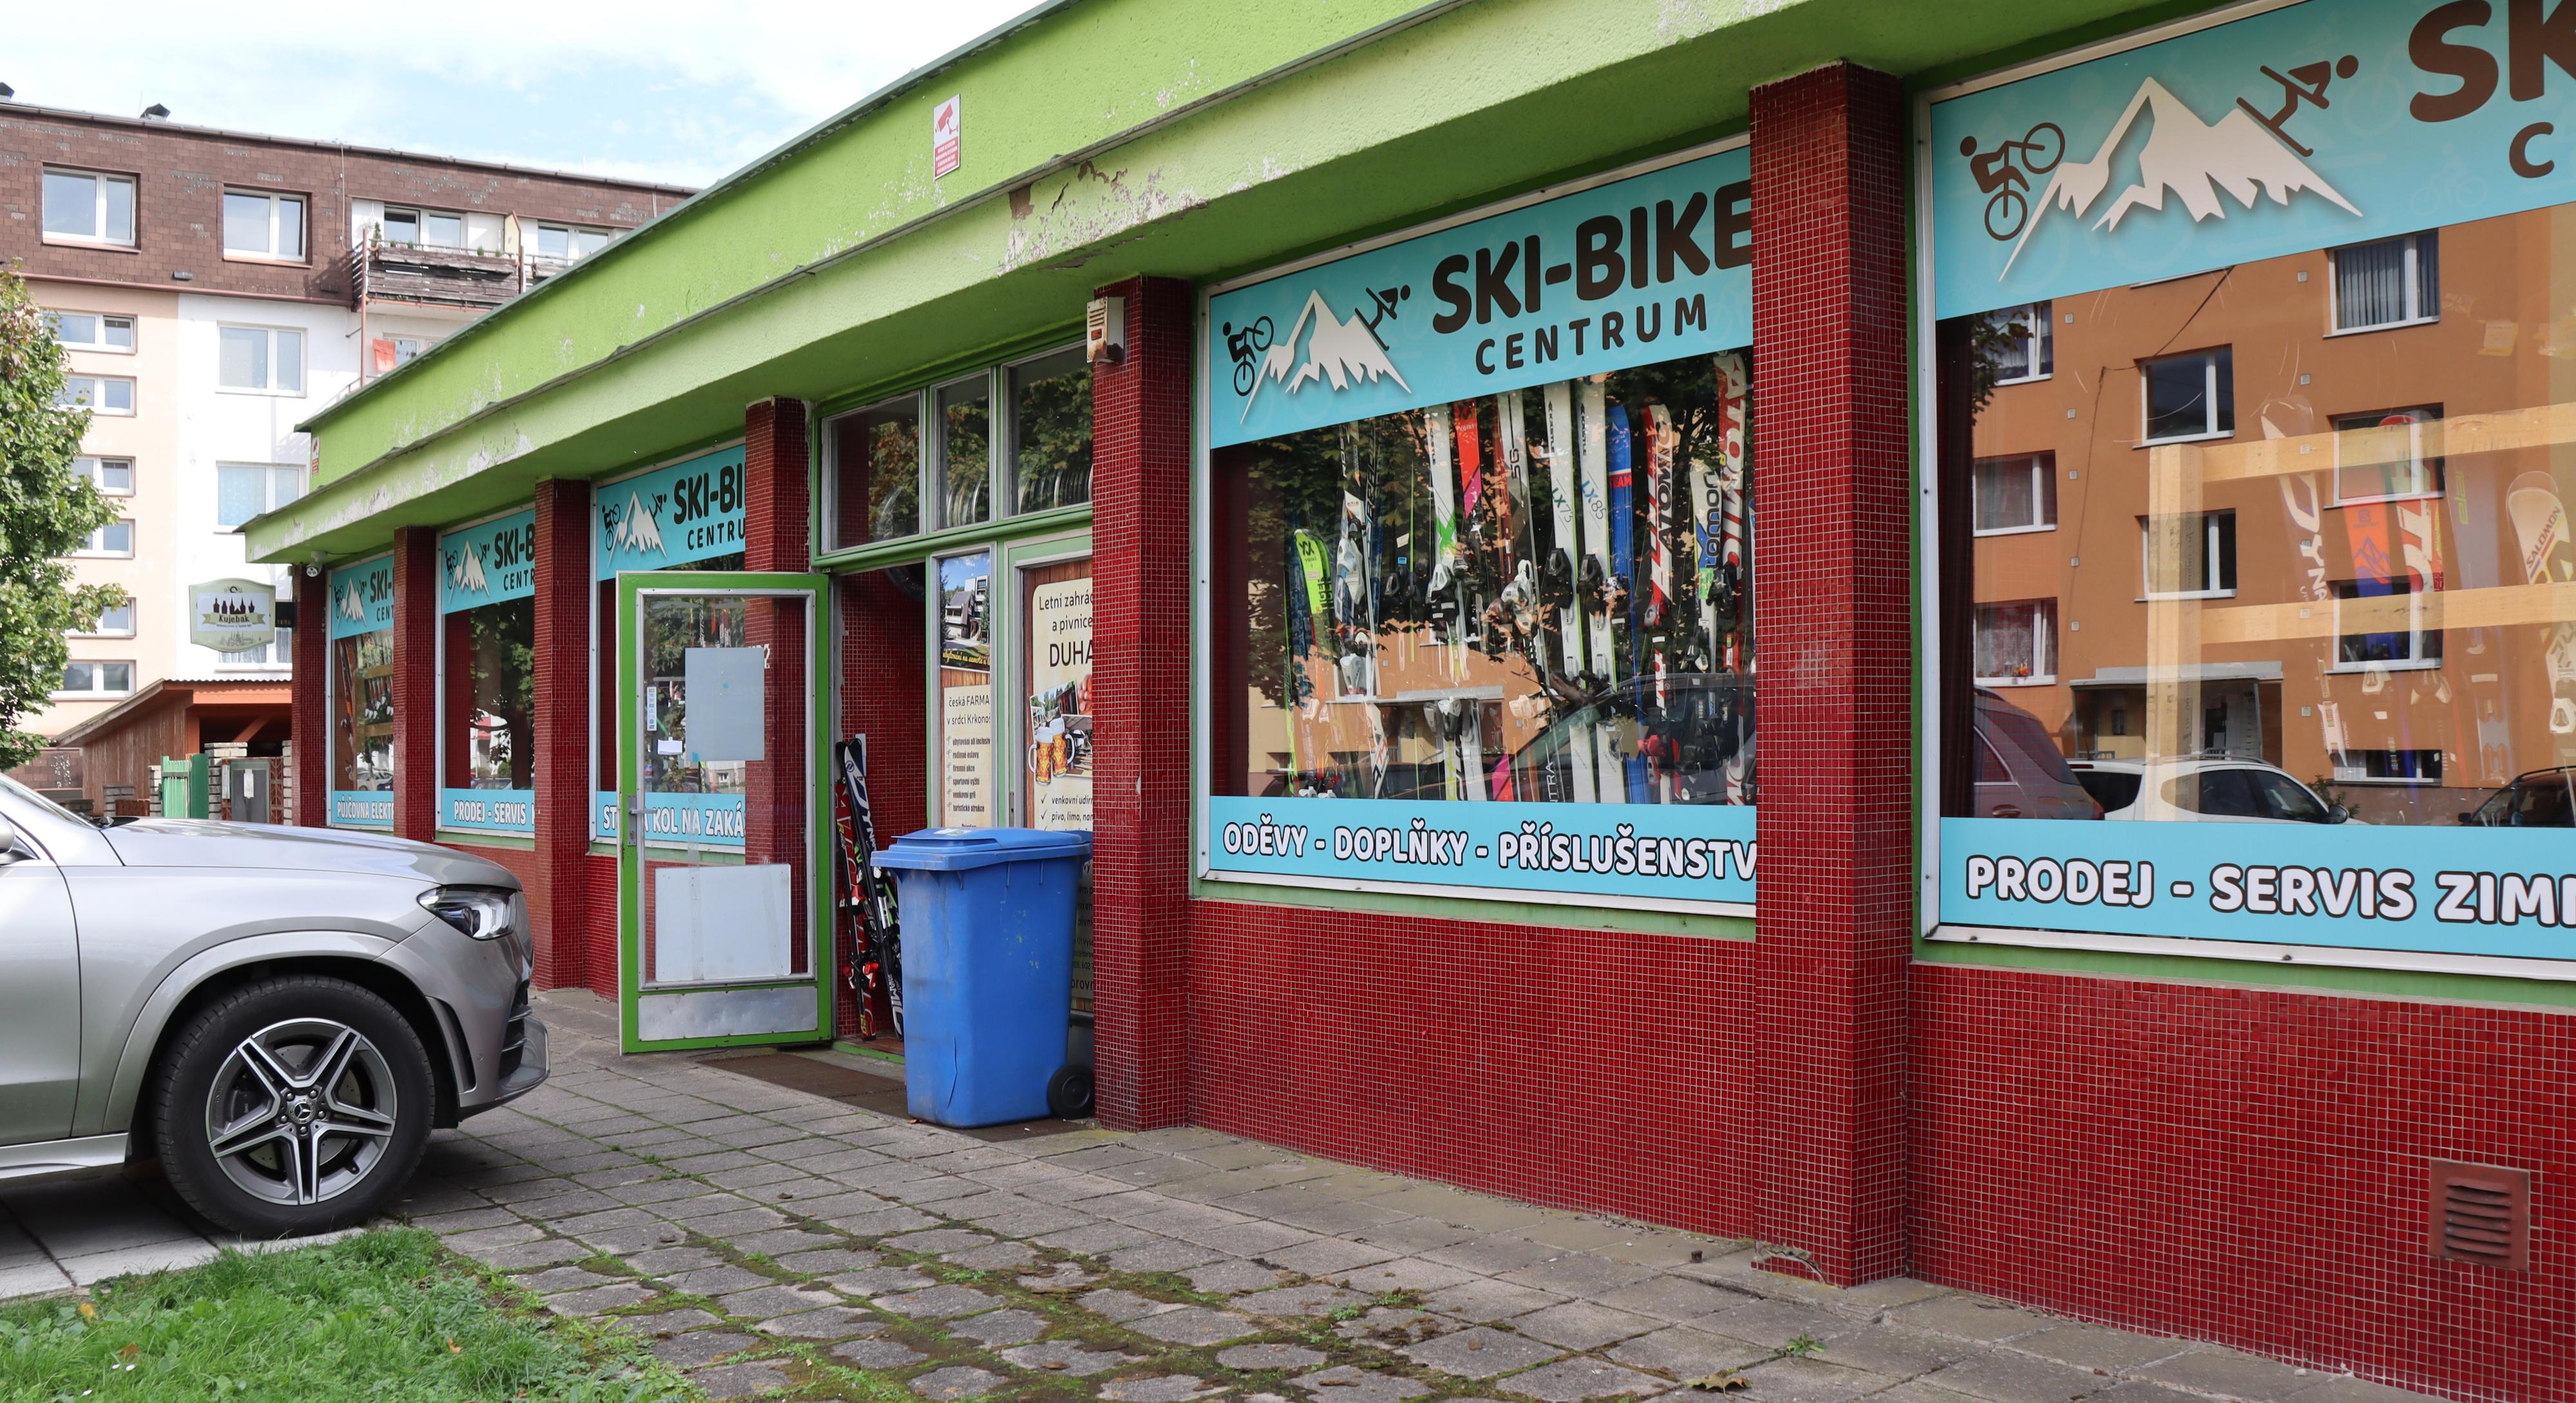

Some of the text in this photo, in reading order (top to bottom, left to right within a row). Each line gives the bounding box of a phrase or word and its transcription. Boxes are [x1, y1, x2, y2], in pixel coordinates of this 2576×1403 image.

[2509, 122, 2555, 178] C
[1432, 179, 1754, 334] SKI-BIKE
[1475, 293, 1707, 375] CENTRUM
[674, 463, 746, 525] SKI-BI
[494, 523, 535, 569] SKI-B
[2526, 506, 2561, 568] SALOMON
[370, 568, 394, 604] SKI-
[1039, 593, 1062, 611] Letní
[1052, 613, 1093, 635] a pivnice
[949, 695, 990, 707] česká FARMA
[951, 714, 966, 725] srdci
[337, 794, 370, 820] PŮJČOVNA
[453, 799, 486, 823] PRODEJ
[494, 801, 527, 825] SERVIS
[652, 806, 679, 834] KOL
[681, 808, 701, 836] NA
[705, 800, 746, 837] ZAKÁ
[1051, 811, 1066, 823] pivo,
[1066, 811, 1081, 822] limo,
[1222, 813, 1756, 882] ODĚVY - DOPLŇKY - PŘÍSLUŠENSTV
[1965, 855, 2155, 908] PRODEJ
[2170, 879, 2195, 899] -
[2208, 862, 2417, 922] SERVIS
